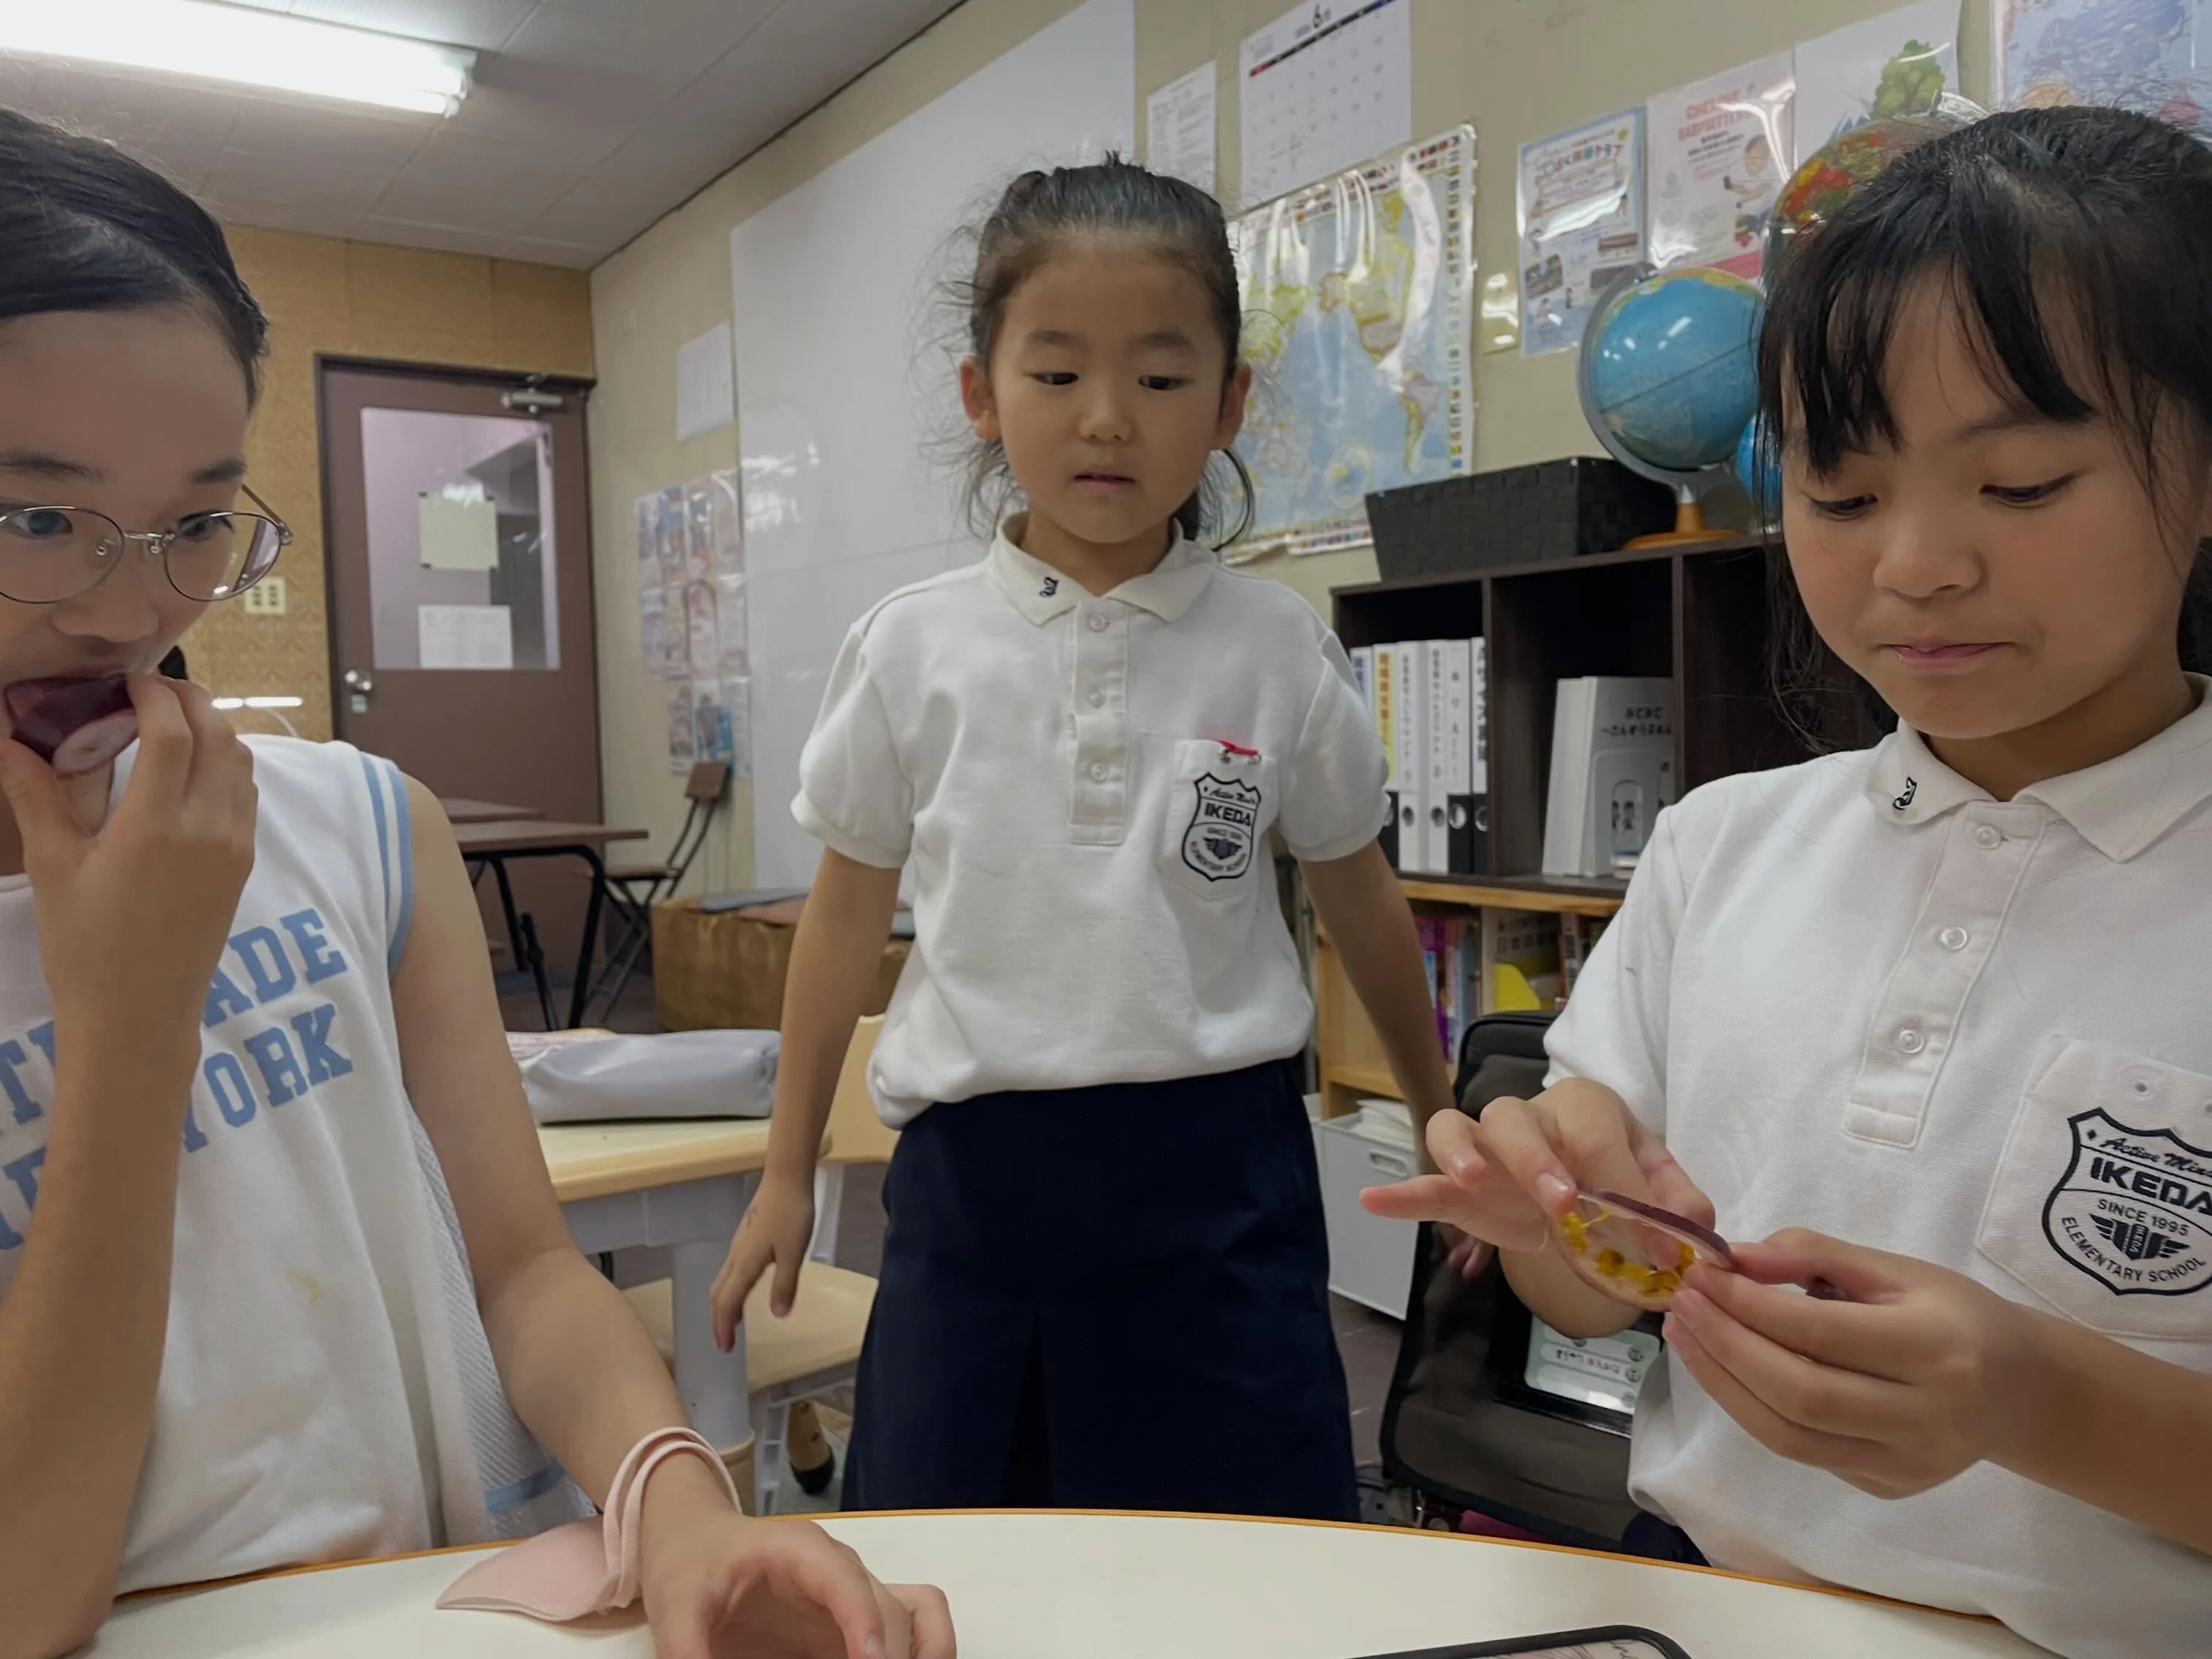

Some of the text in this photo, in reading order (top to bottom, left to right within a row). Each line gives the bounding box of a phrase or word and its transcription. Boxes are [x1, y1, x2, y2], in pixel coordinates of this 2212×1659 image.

[1205, 802, 1251, 827] IKEDA
[202, 907, 348, 1028] ADE
[2090, 1156, 2212, 1216] IKEDA
[2097, 1198, 2191, 1236] SINCE 1995
[2061, 1216, 2208, 1283] ELEMENTARY SCHOOL
